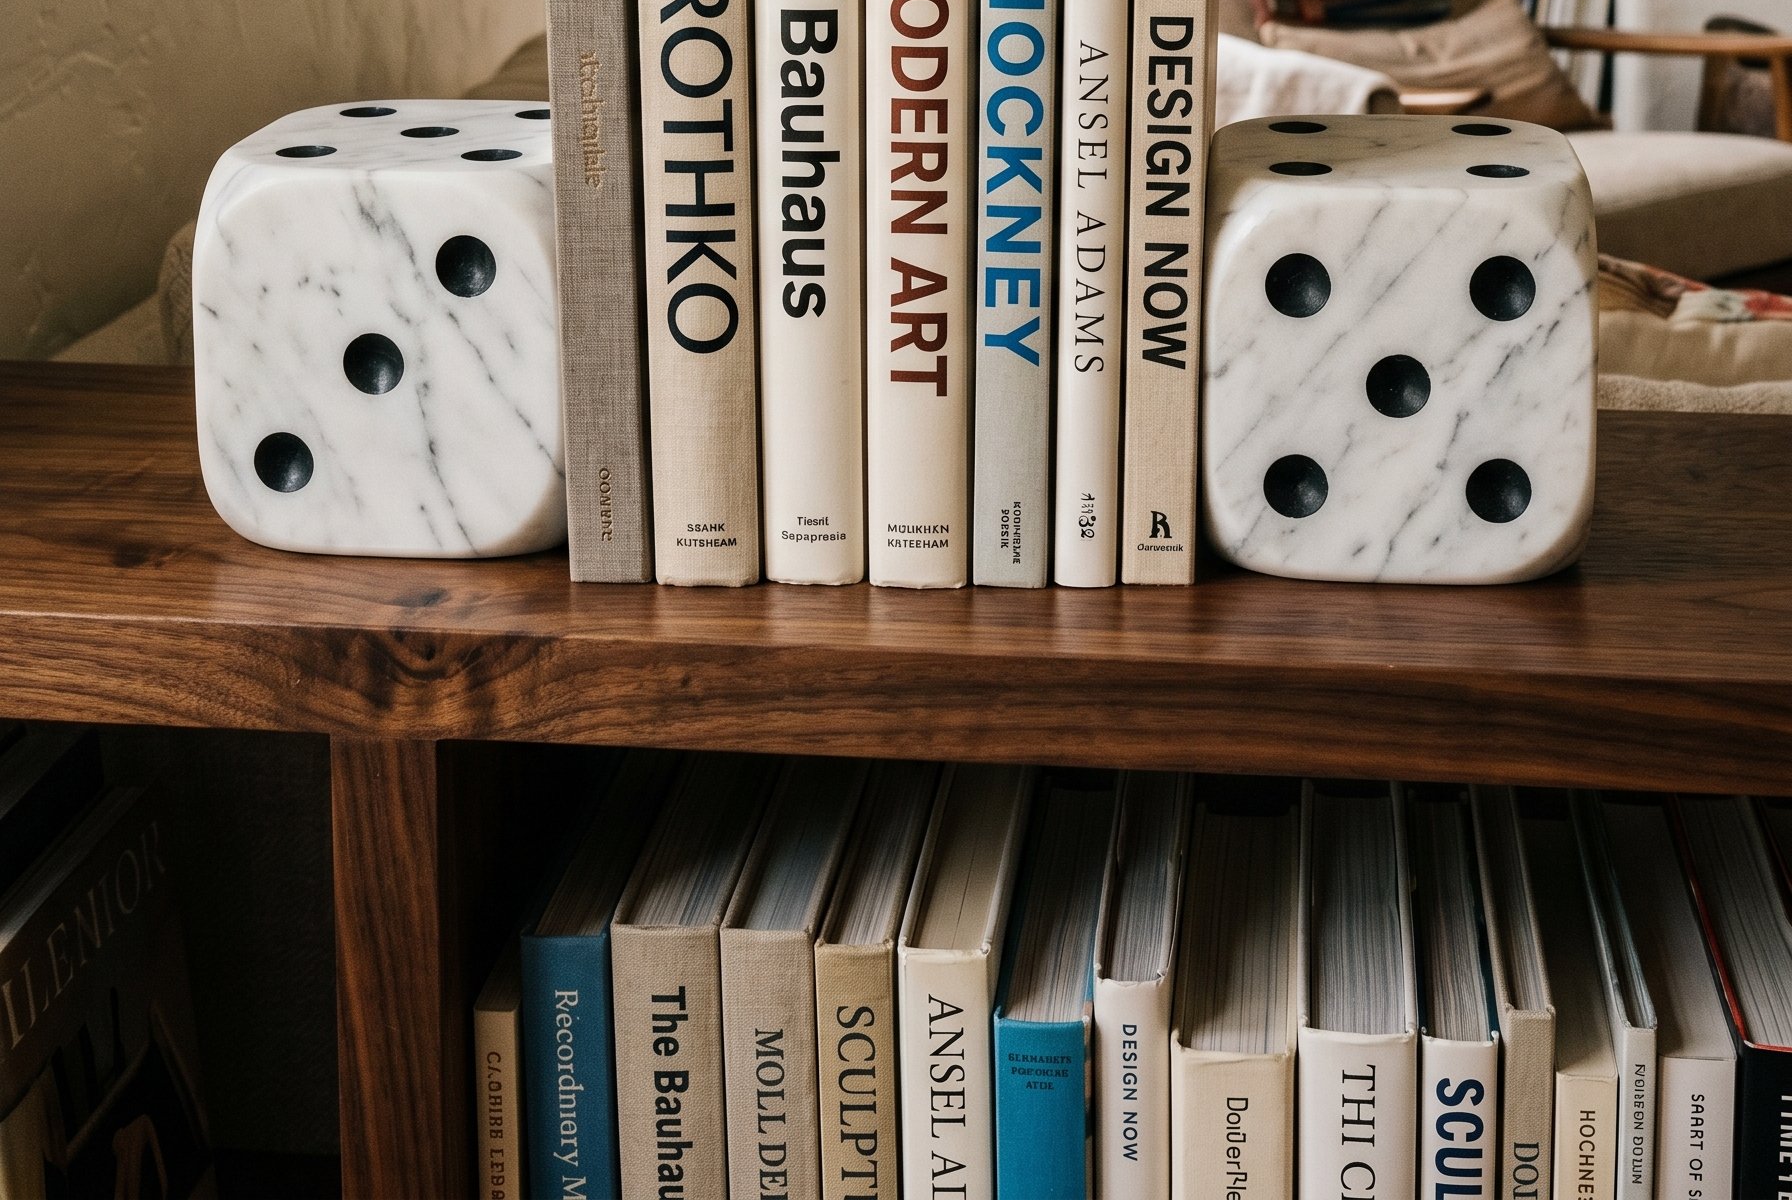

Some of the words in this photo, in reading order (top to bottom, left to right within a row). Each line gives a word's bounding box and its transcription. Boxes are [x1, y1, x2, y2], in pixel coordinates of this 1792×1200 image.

[780, 8, 841, 319] Bauhaus
[1076, 39, 1111, 189] ANSEL
[1144, 15, 1195, 217] DESIGN
[889, 257, 949, 398] ART
[1073, 209, 1108, 374] ADAMS
[1141, 241, 1190, 371] NOW
[650, 984, 690, 1058] The
[927, 993, 967, 1140] ANSEL
[1122, 1023, 1139, 1101] DESIGN
[754, 1027, 787, 1135] MOLL
[835, 1004, 880, 1200] SCULPT
[1122, 1110, 1139, 1162] NOW
[1340, 1063, 1377, 1148] THI
[1690, 1093, 1706, 1151] SAART
[1339, 1161, 1377, 1200] C
[1689, 1157, 1704, 1183] OF
